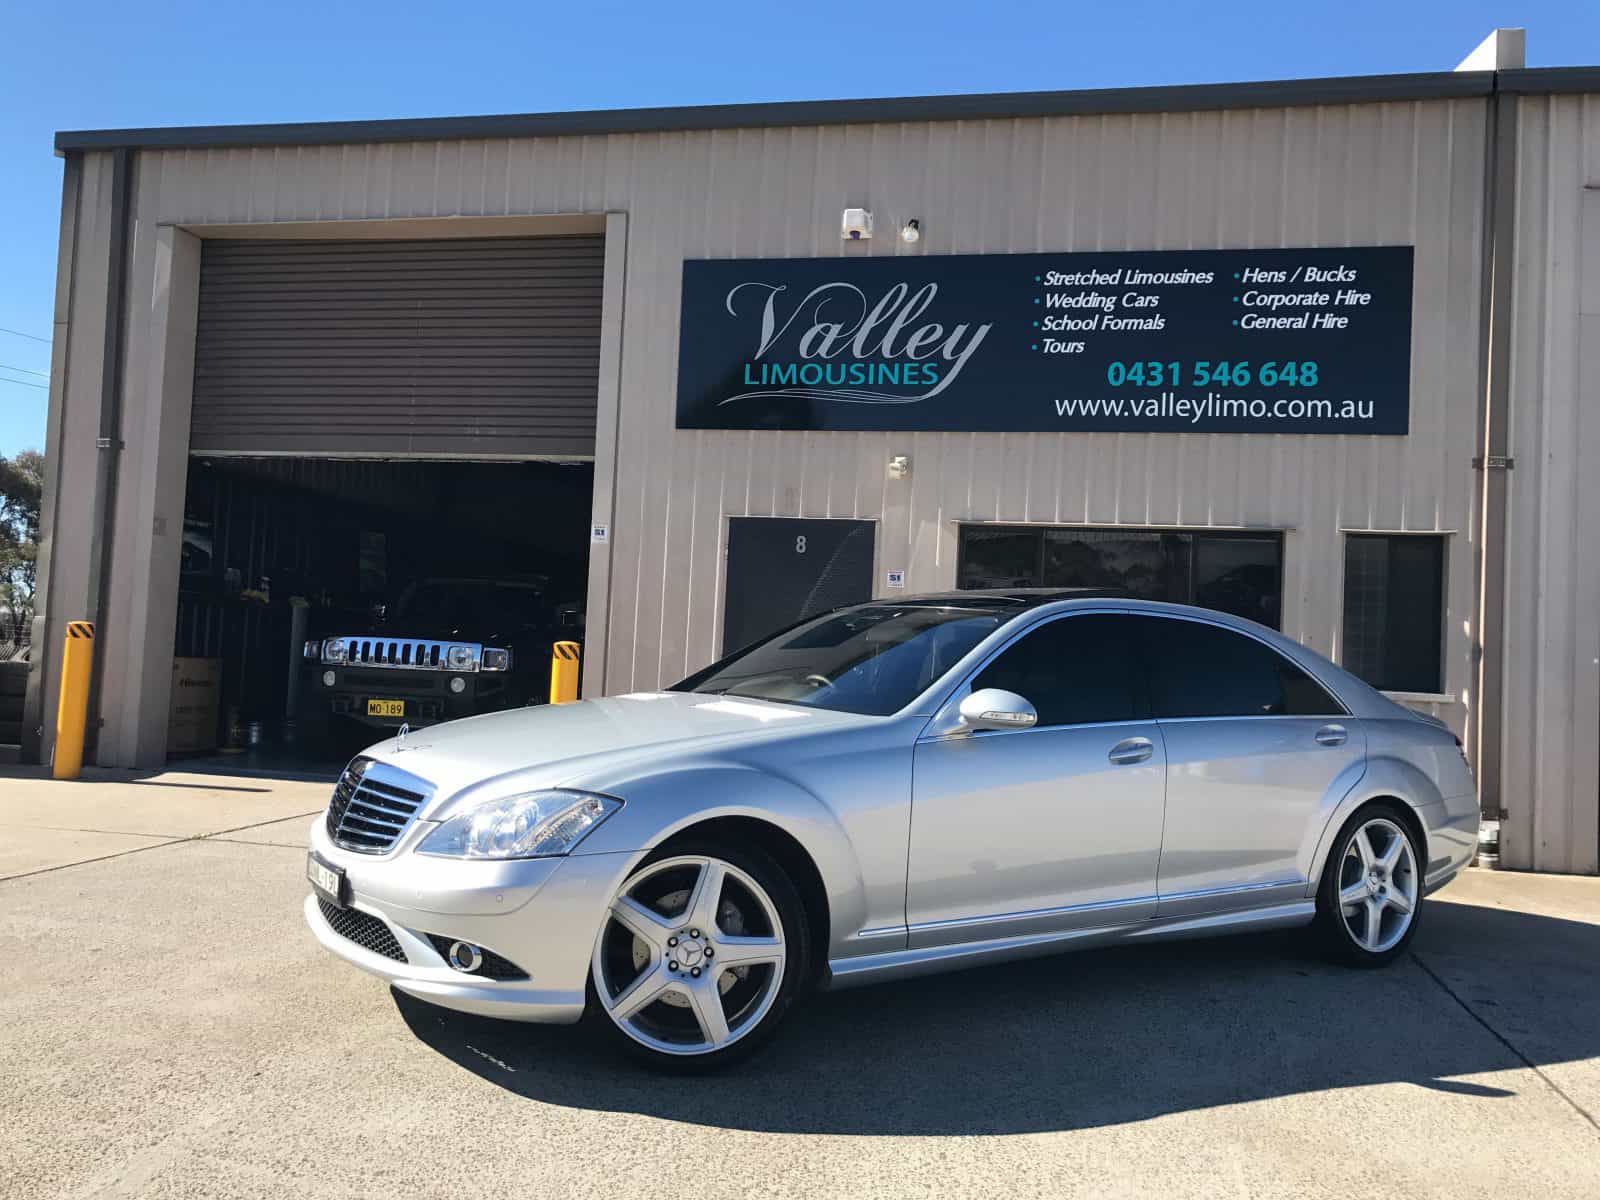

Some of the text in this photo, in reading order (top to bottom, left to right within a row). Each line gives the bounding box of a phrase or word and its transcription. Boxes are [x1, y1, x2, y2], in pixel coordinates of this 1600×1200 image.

[1044, 269, 1214, 285] Stretched Limousines
[1242, 265, 1356, 282] Hens / Bucks
[1047, 292, 1159, 312] Wedding Cars
[1243, 290, 1371, 310] Corporate Hire
[1042, 314, 1165, 330] School Formals
[1241, 312, 1348, 328] General Hire
[726, 282, 992, 401] Valley
[1043, 339, 1085, 353] Tours
[745, 363, 938, 384] LIMOUSINES
[1108, 362, 1318, 386] 0431 546 648
[1055, 392, 1373, 423] www.valleylimo.com.au
[795, 536, 807, 553] 8
